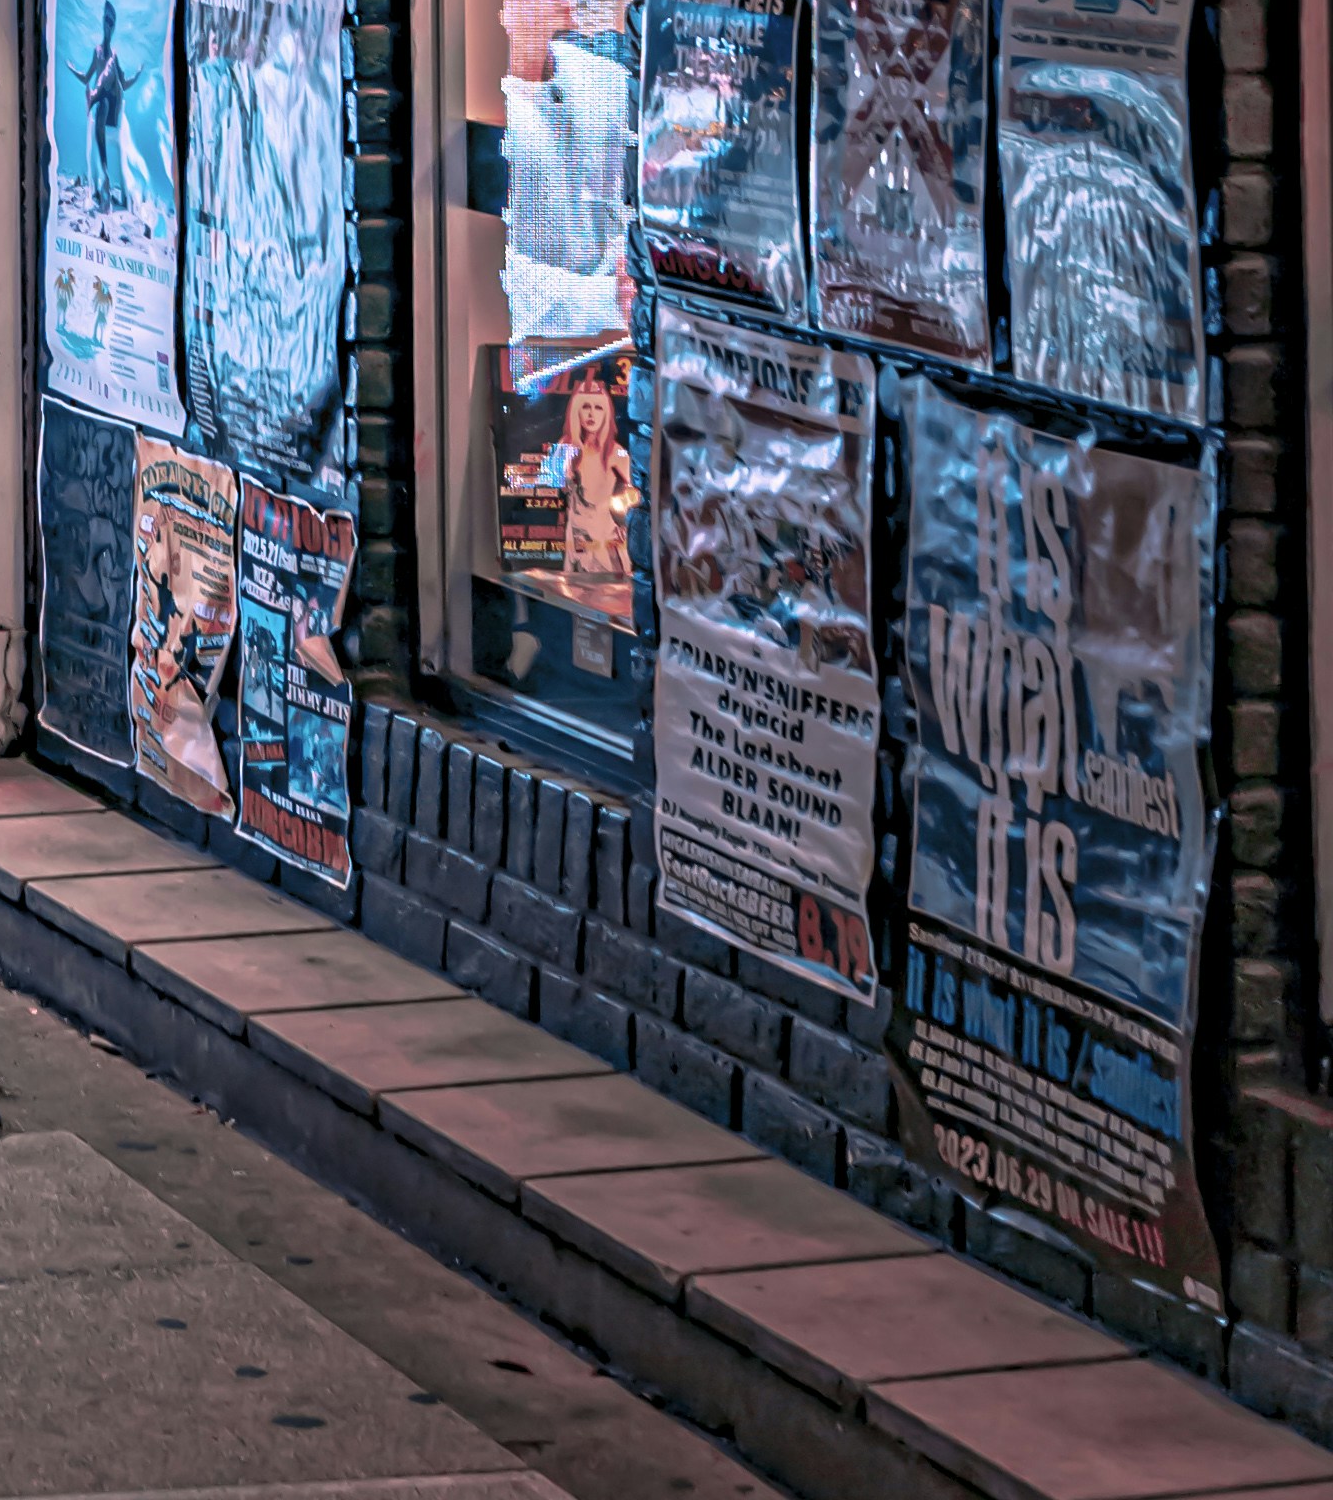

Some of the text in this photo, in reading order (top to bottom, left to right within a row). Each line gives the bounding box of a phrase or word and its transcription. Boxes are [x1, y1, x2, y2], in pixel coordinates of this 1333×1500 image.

[689, 711, 843, 792] The Ladsbeat
[689, 746, 843, 827] ALDER SOUND
[660, 797, 678, 820] DJ
[721, 790, 802, 847] BLAAN!
[798, 893, 871, 985] 8.19
[1083, 1194, 1132, 1253] SALE
